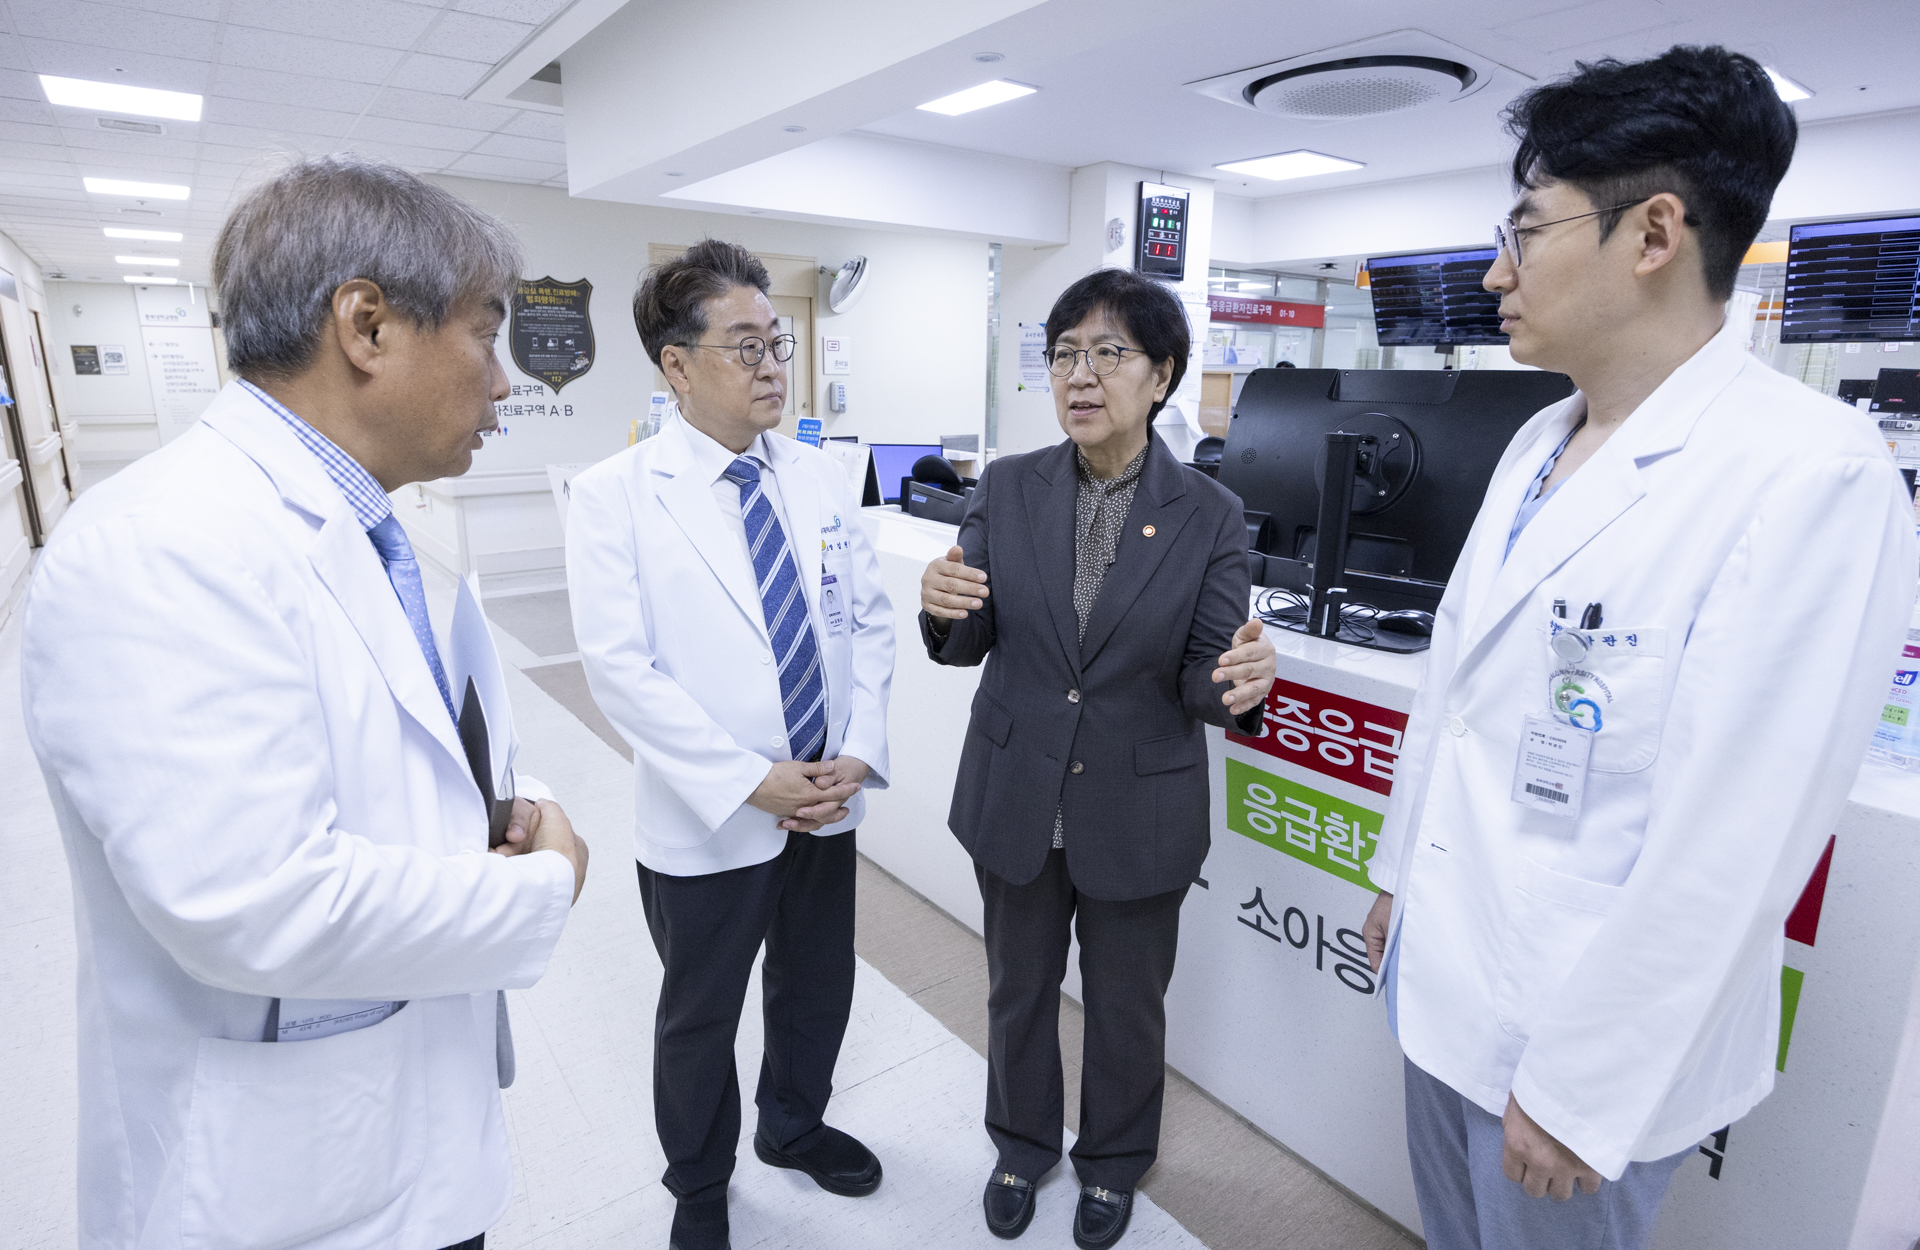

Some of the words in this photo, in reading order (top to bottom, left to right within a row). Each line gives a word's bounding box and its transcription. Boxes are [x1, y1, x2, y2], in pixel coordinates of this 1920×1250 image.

[1279, 309, 1295, 319] 01-10
[509, 385, 544, 396] 료구역
[1243, 783, 1379, 872] 응급환
[1237, 886, 1379, 994] 소아응
